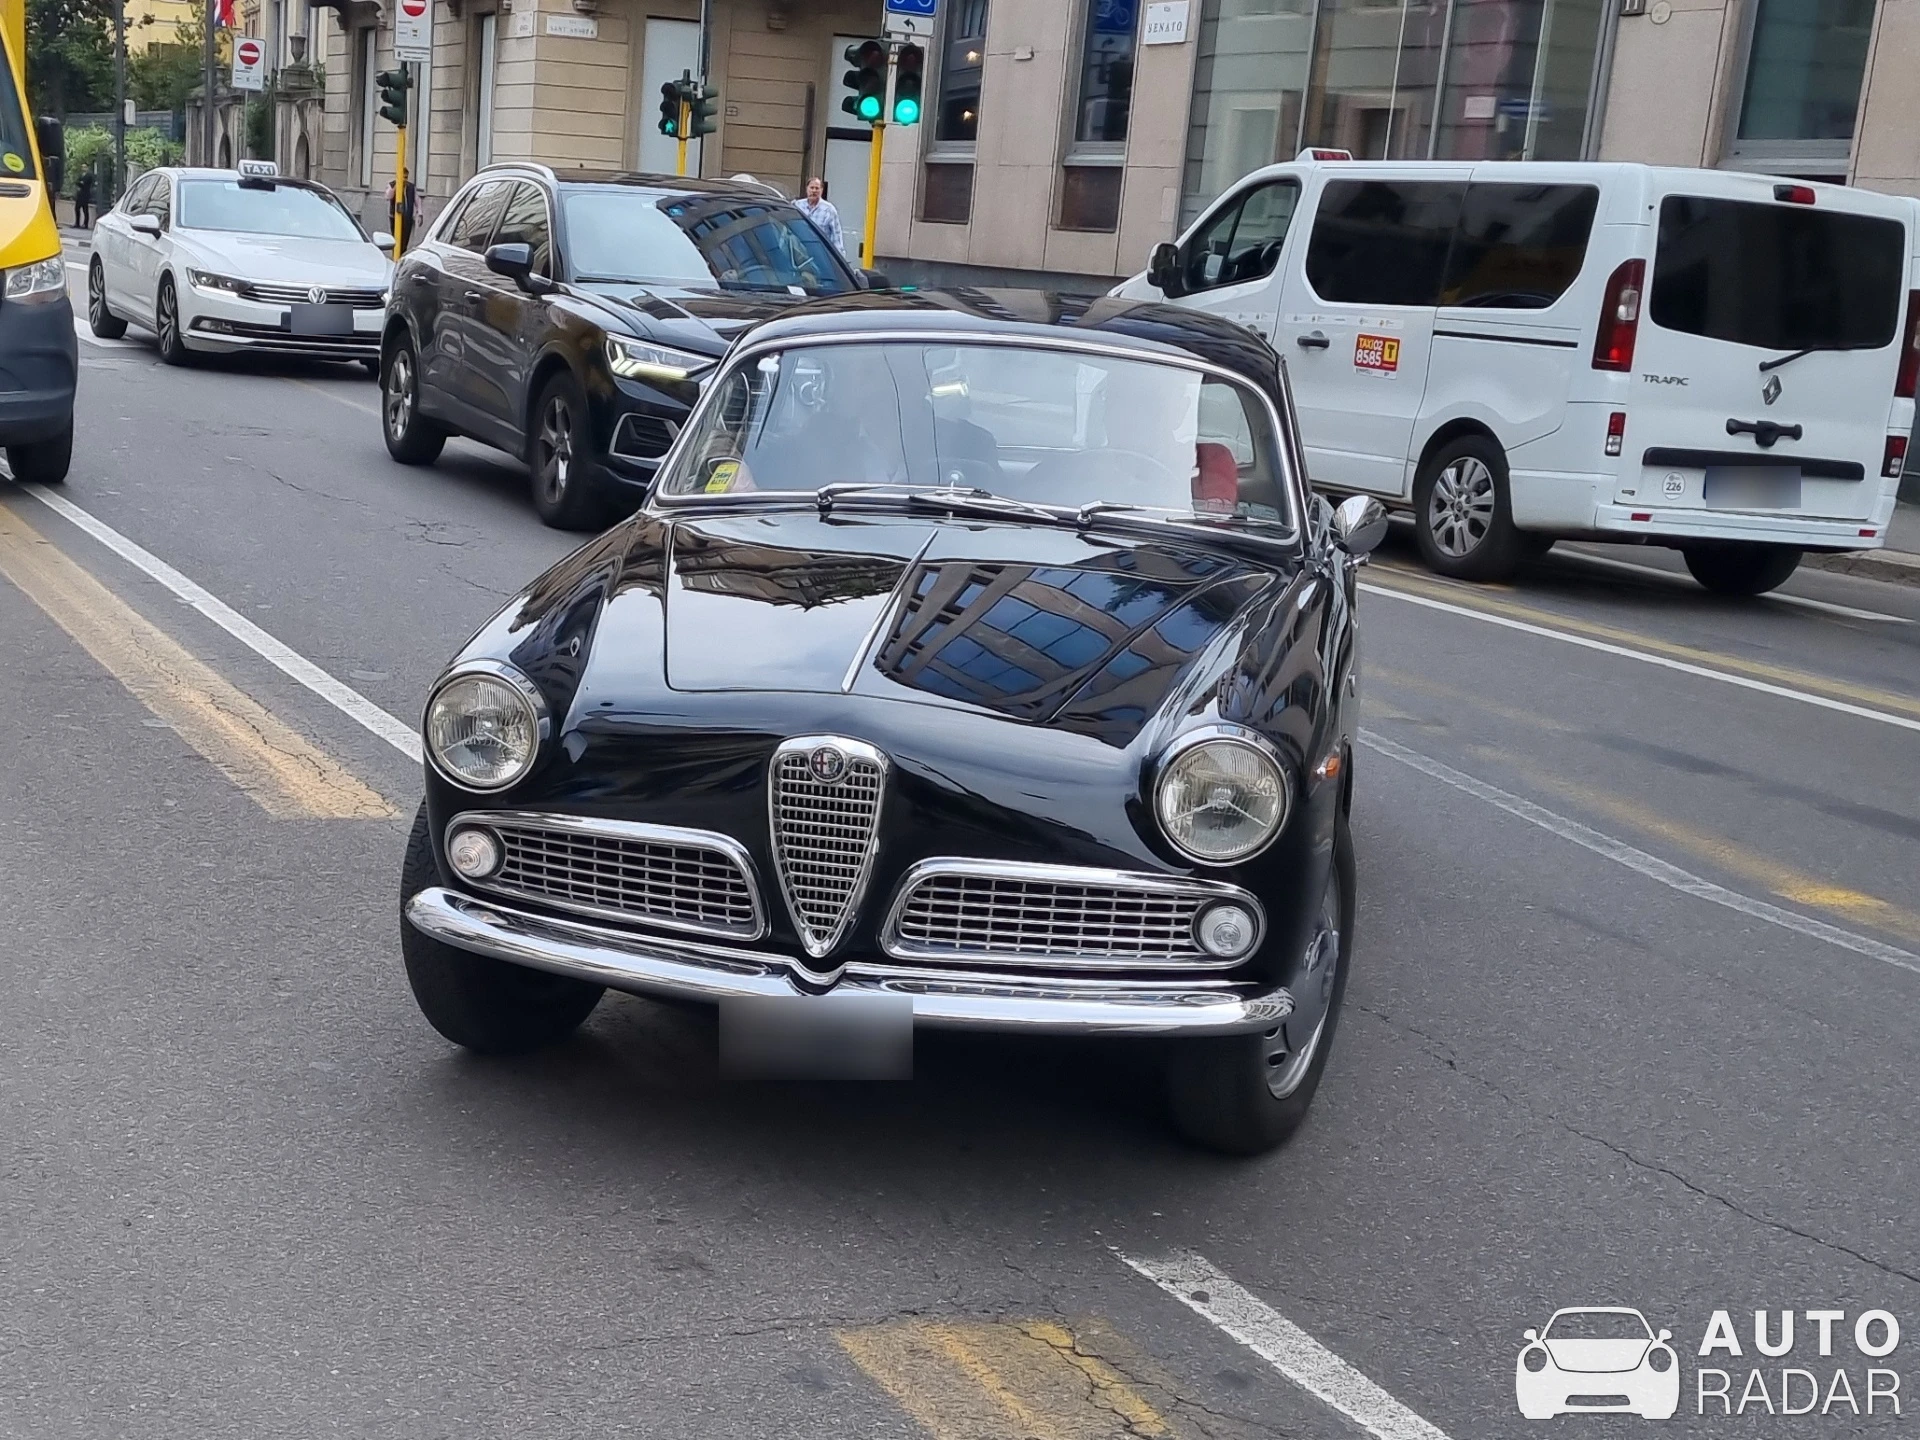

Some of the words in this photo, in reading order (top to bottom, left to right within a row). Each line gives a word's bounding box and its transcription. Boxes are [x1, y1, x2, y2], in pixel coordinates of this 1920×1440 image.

[1148, 21, 1183, 33] SENATO
[244, 164, 274, 175] TAXI
[1356, 348, 1382, 366] 8585
[1642, 373, 1690, 386] TRAFIC
[1666, 482, 1682, 492] 226
